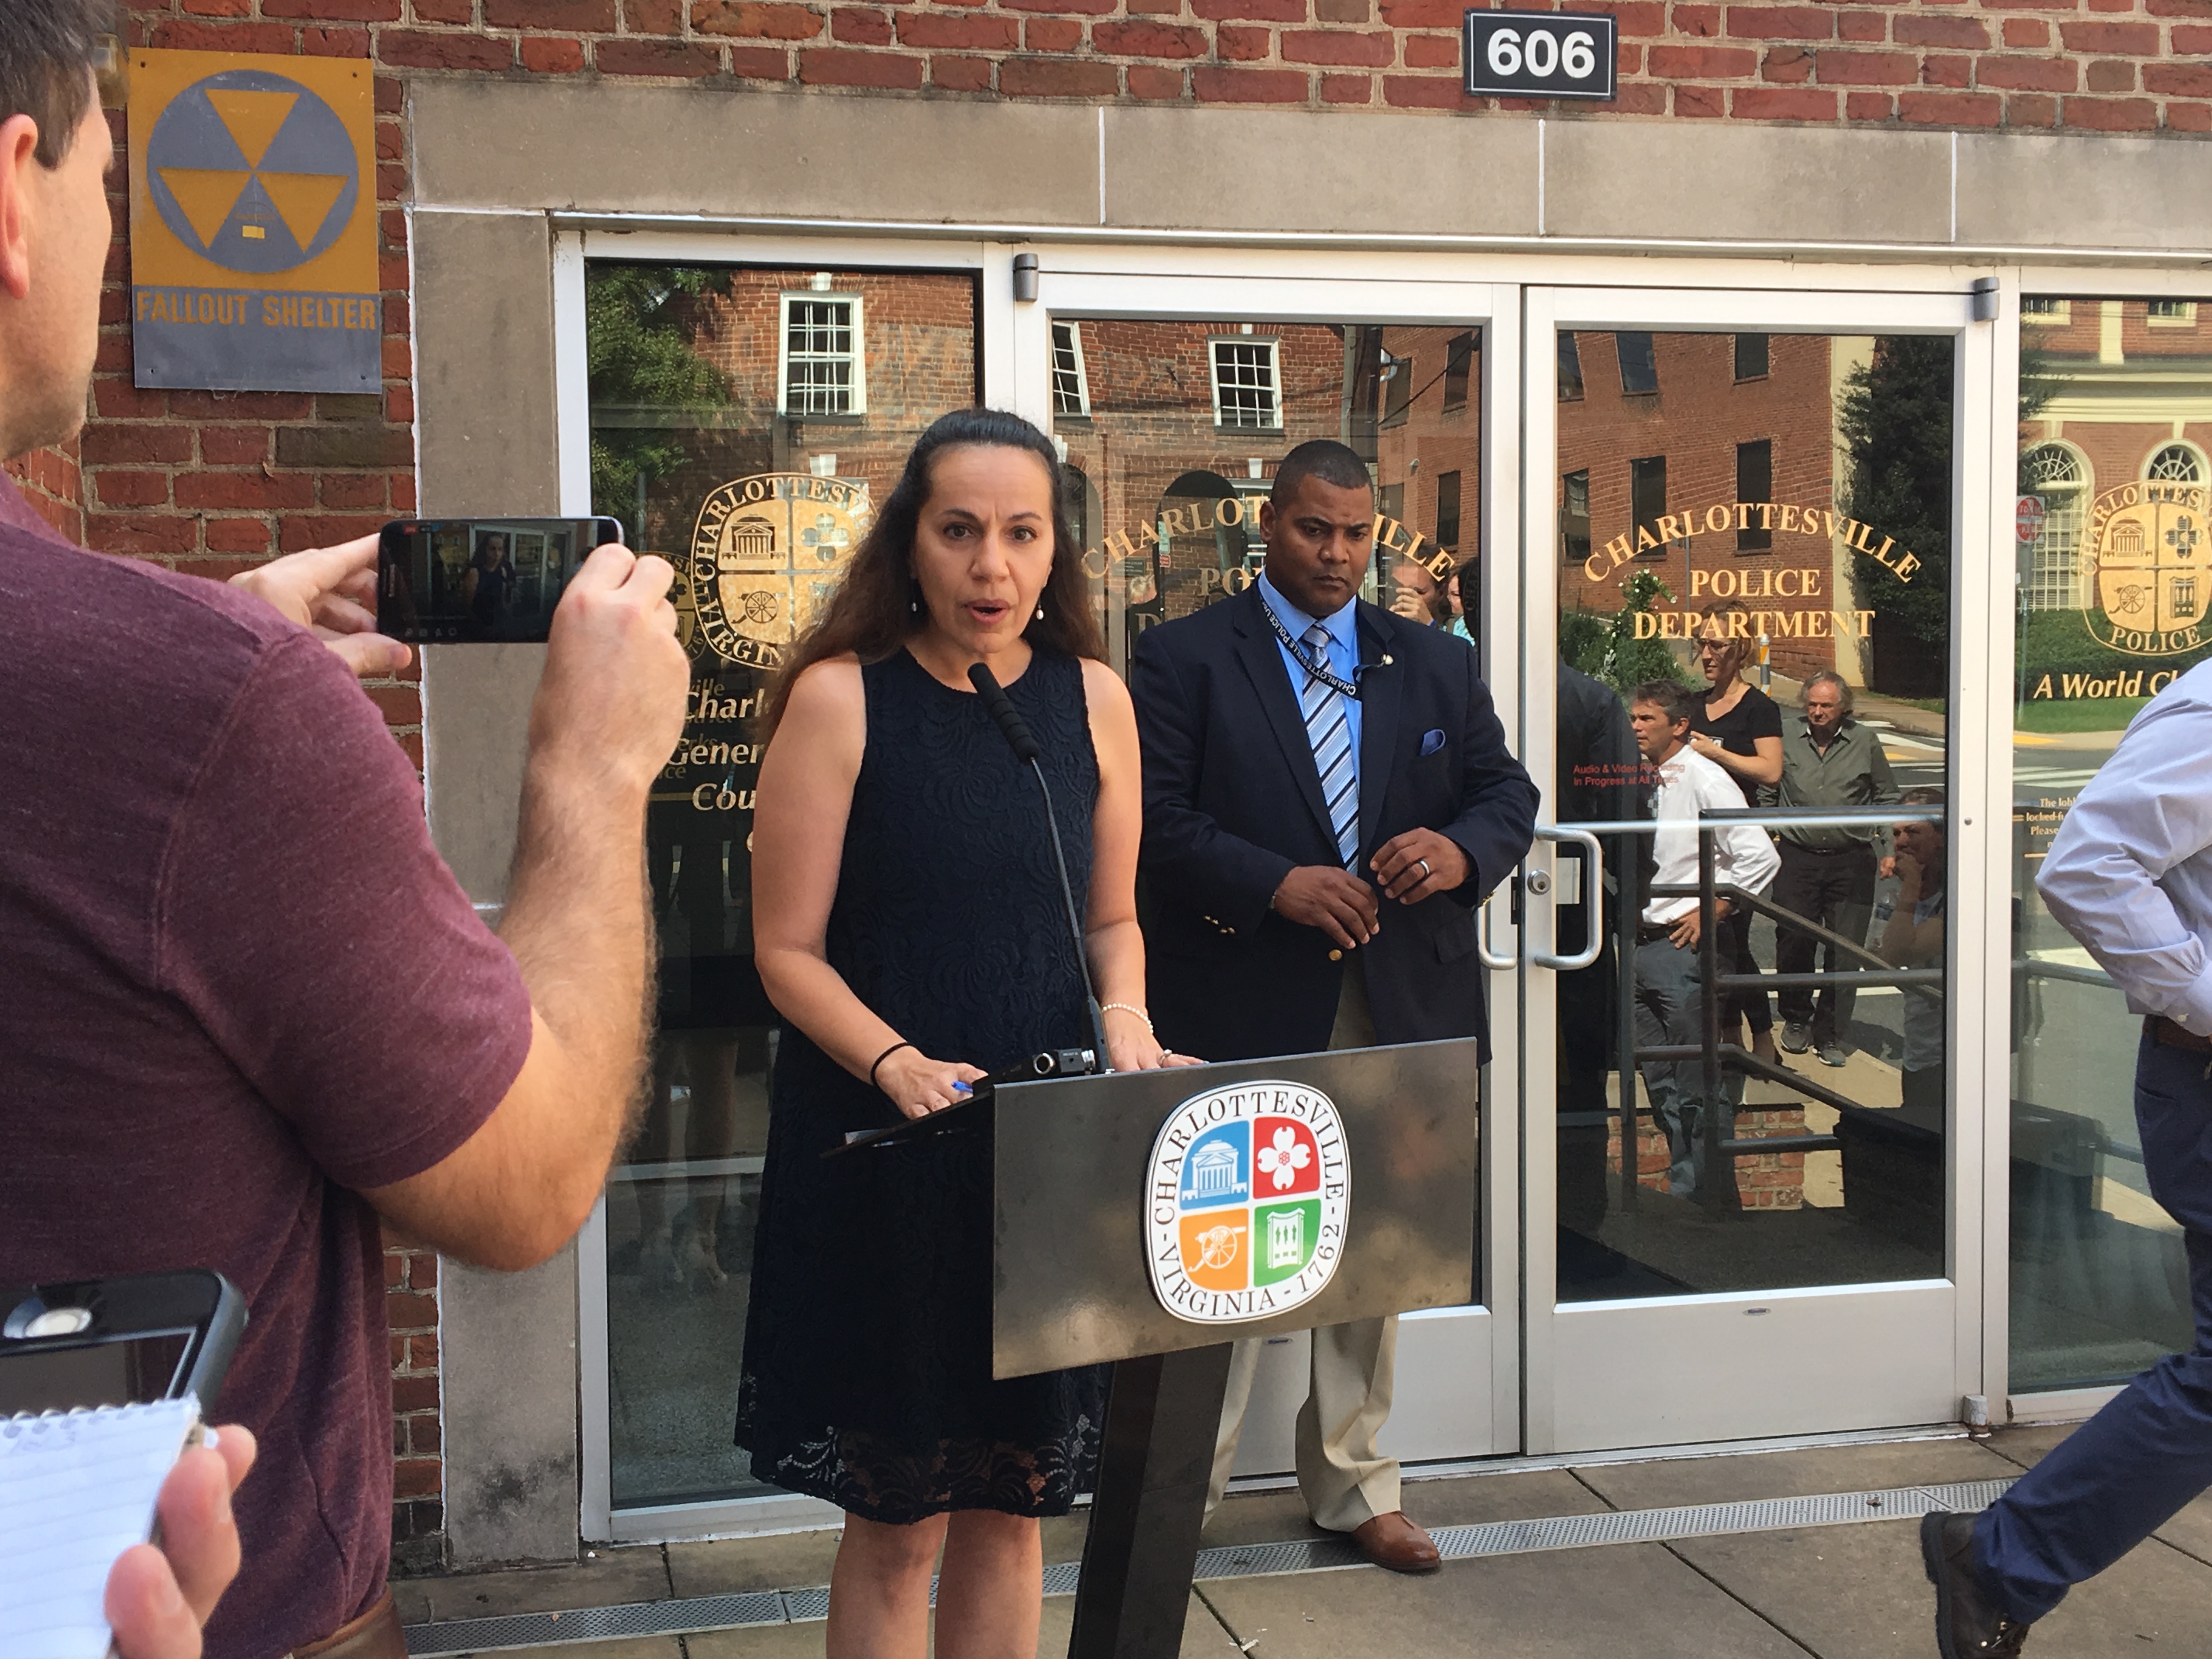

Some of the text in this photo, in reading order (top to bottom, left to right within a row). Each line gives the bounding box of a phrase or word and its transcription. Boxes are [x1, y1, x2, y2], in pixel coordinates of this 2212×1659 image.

[1488, 28, 1595, 78] 606
[137, 292, 376, 330] FALLOUT SHELTER
[1584, 503, 1921, 584] CHARLOTTESVILLE
[1689, 569, 1821, 597] POLICE
[1633, 610, 1876, 640] DEPARTMENT
[2109, 625, 2201, 652] POLICE
[2034, 674, 2053, 699] A
[2062, 671, 2143, 698] World
[1573, 764, 1599, 774] Audio
[1602, 764, 1609, 773] &
[1612, 764, 1638, 773] Video
[1585, 776, 1626, 788] Progress
[1638, 775, 1650, 785] All
[1652, 775, 1679, 784] Times
[2040, 798, 2057, 808] The
[1155, 1091, 1344, 1224] CHARLOTTESVILLE
[1159, 1243, 1277, 1316] VIRGINIA
